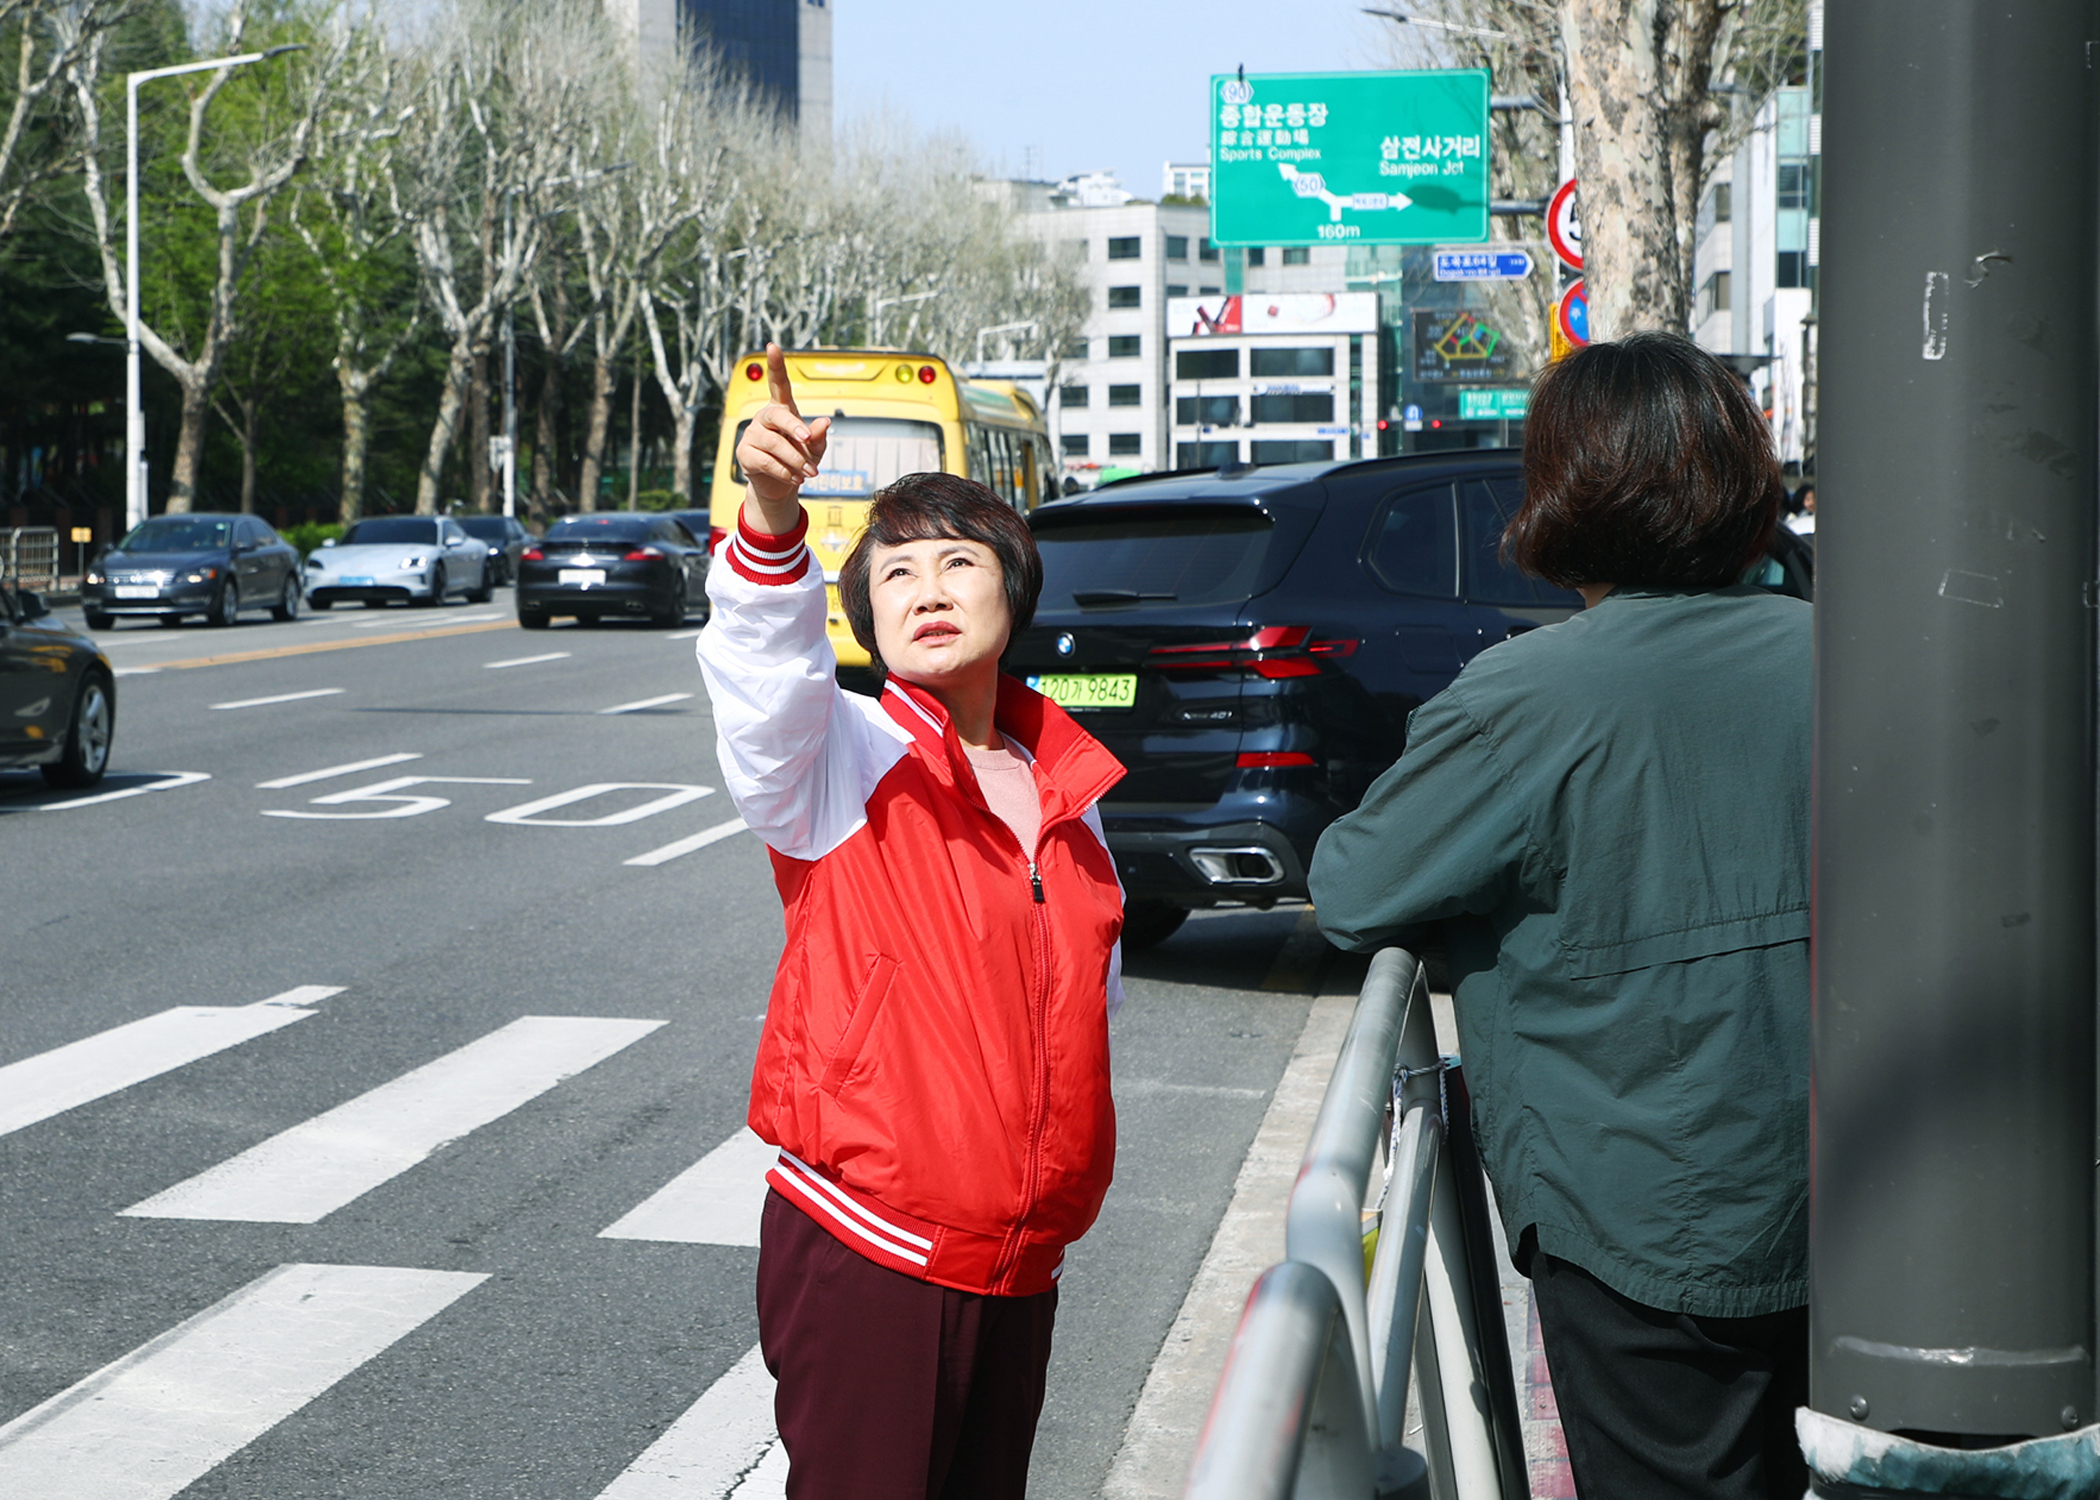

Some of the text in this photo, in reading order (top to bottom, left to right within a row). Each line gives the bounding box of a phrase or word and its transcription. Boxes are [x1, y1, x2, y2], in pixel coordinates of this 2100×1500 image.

[1228, 83, 1247, 100] 90
[1220, 102, 1329, 128] 종합운동장
[1220, 145, 1322, 162] Sports Complex
[1380, 135, 1480, 160] 삼전사거리
[1379, 160, 1464, 179] Samjeon Jct
[1300, 178, 1319, 194] 50
[1317, 223, 1361, 239] 160m
[1088, 678, 1130, 701] 9843
[259, 775, 716, 826] 50
